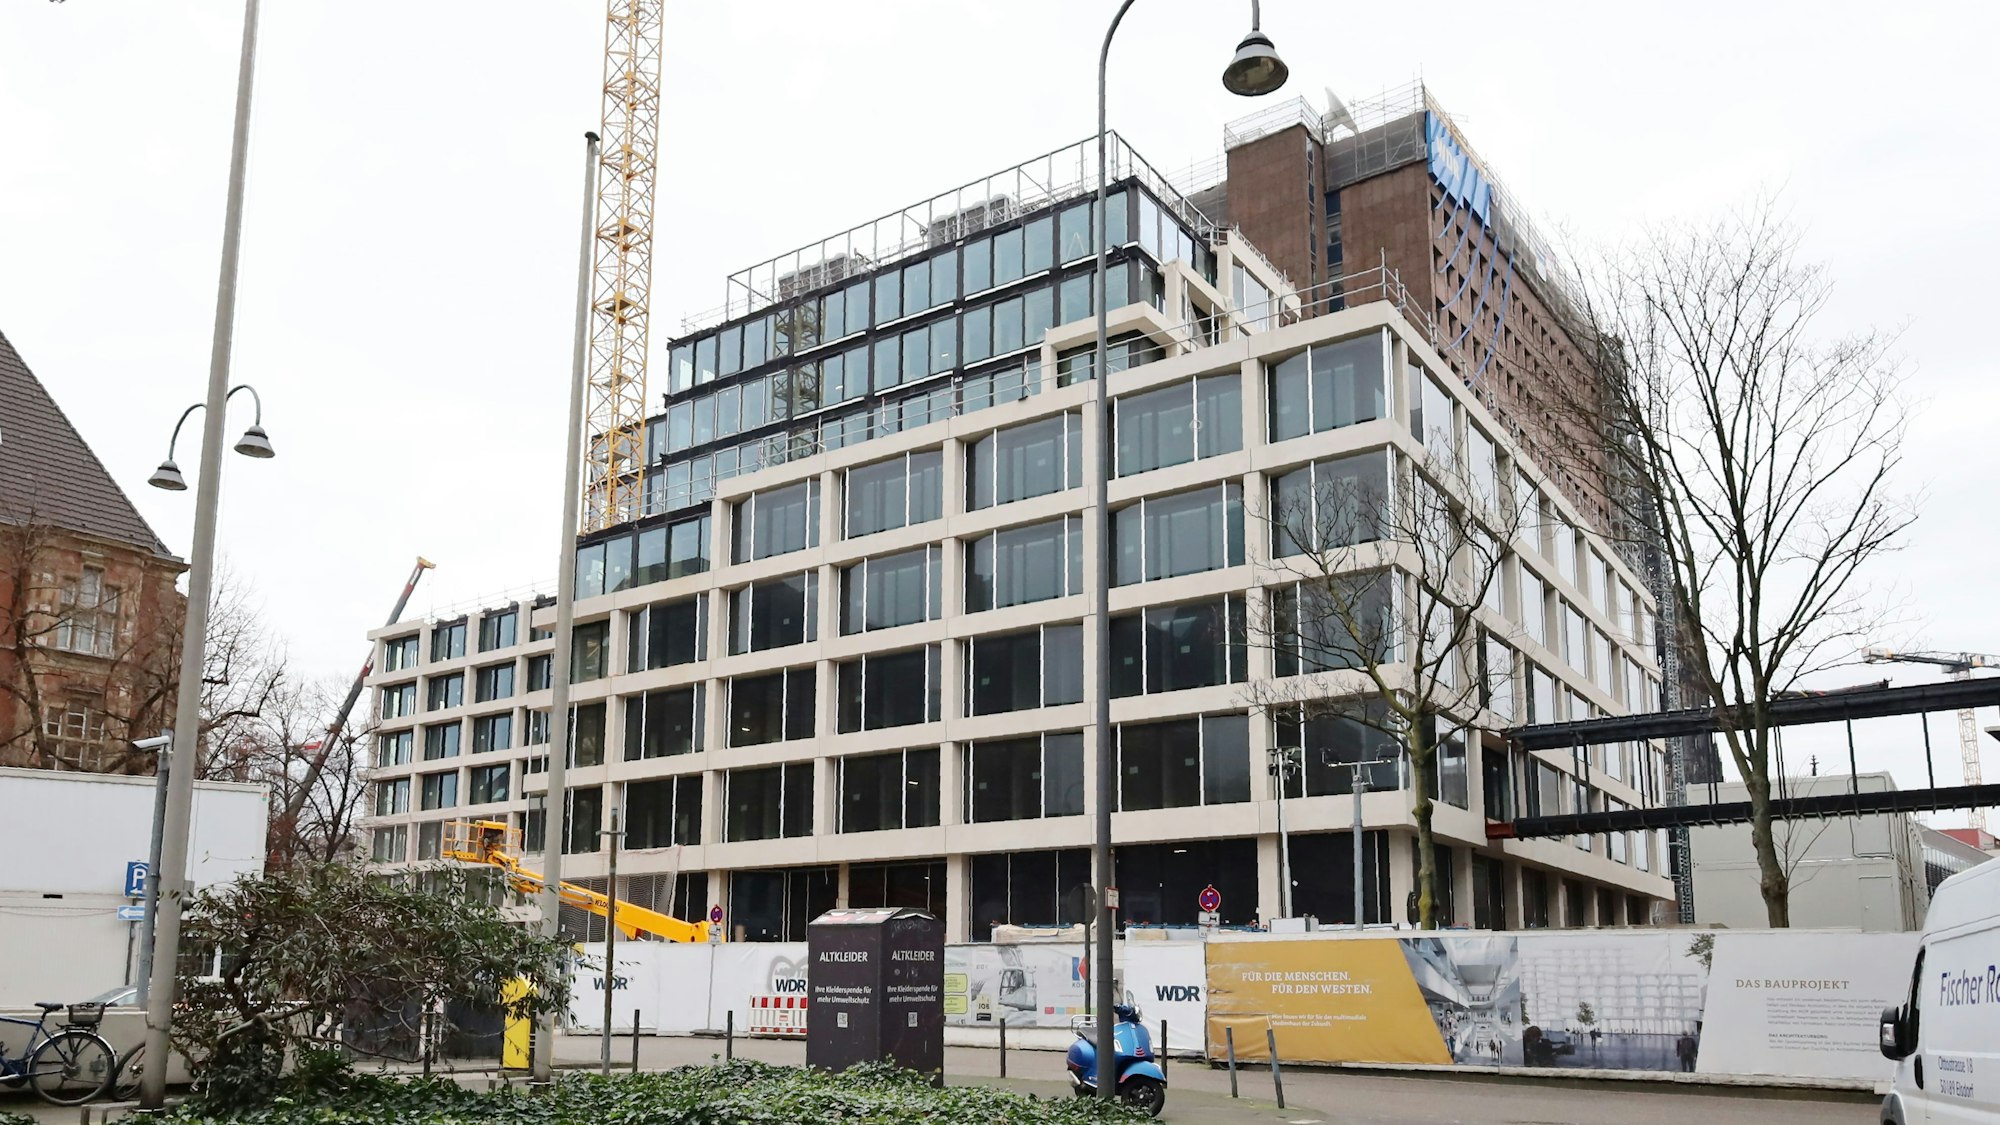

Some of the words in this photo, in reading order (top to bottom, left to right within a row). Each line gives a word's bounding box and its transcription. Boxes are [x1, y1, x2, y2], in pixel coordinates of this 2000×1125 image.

[132, 868, 147, 888] P
[819, 951, 869, 962] ALTKLEIDER
[891, 950, 935, 961] ALTKLEIDER
[1242, 971, 1263, 982] FÜR
[1264, 972, 1283, 982] DIE
[1284, 971, 1351, 981] MENSCHEN.
[775, 978, 807, 992] WDR
[814, 985, 826, 993] Ihre
[826, 985, 863, 996] Kleiderspende
[863, 985, 872, 993] für
[898, 984, 931, 995] Kleiderspende
[1272, 983, 1293, 994] FÜR
[1295, 984, 1318, 994] DEN
[1321, 984, 1373, 994] WESTEN.
[1735, 979, 1761, 988] DAS
[1764, 979, 1850, 991] BAUPROJEKT
[1940, 969, 1983, 1007] Fischer
[903, 994, 937, 1002] Umweltschutz
[1155, 985, 1201, 1002] WDR
[816, 995, 831, 1003] mehr
[831, 995, 870, 1004] Umweltschutz
